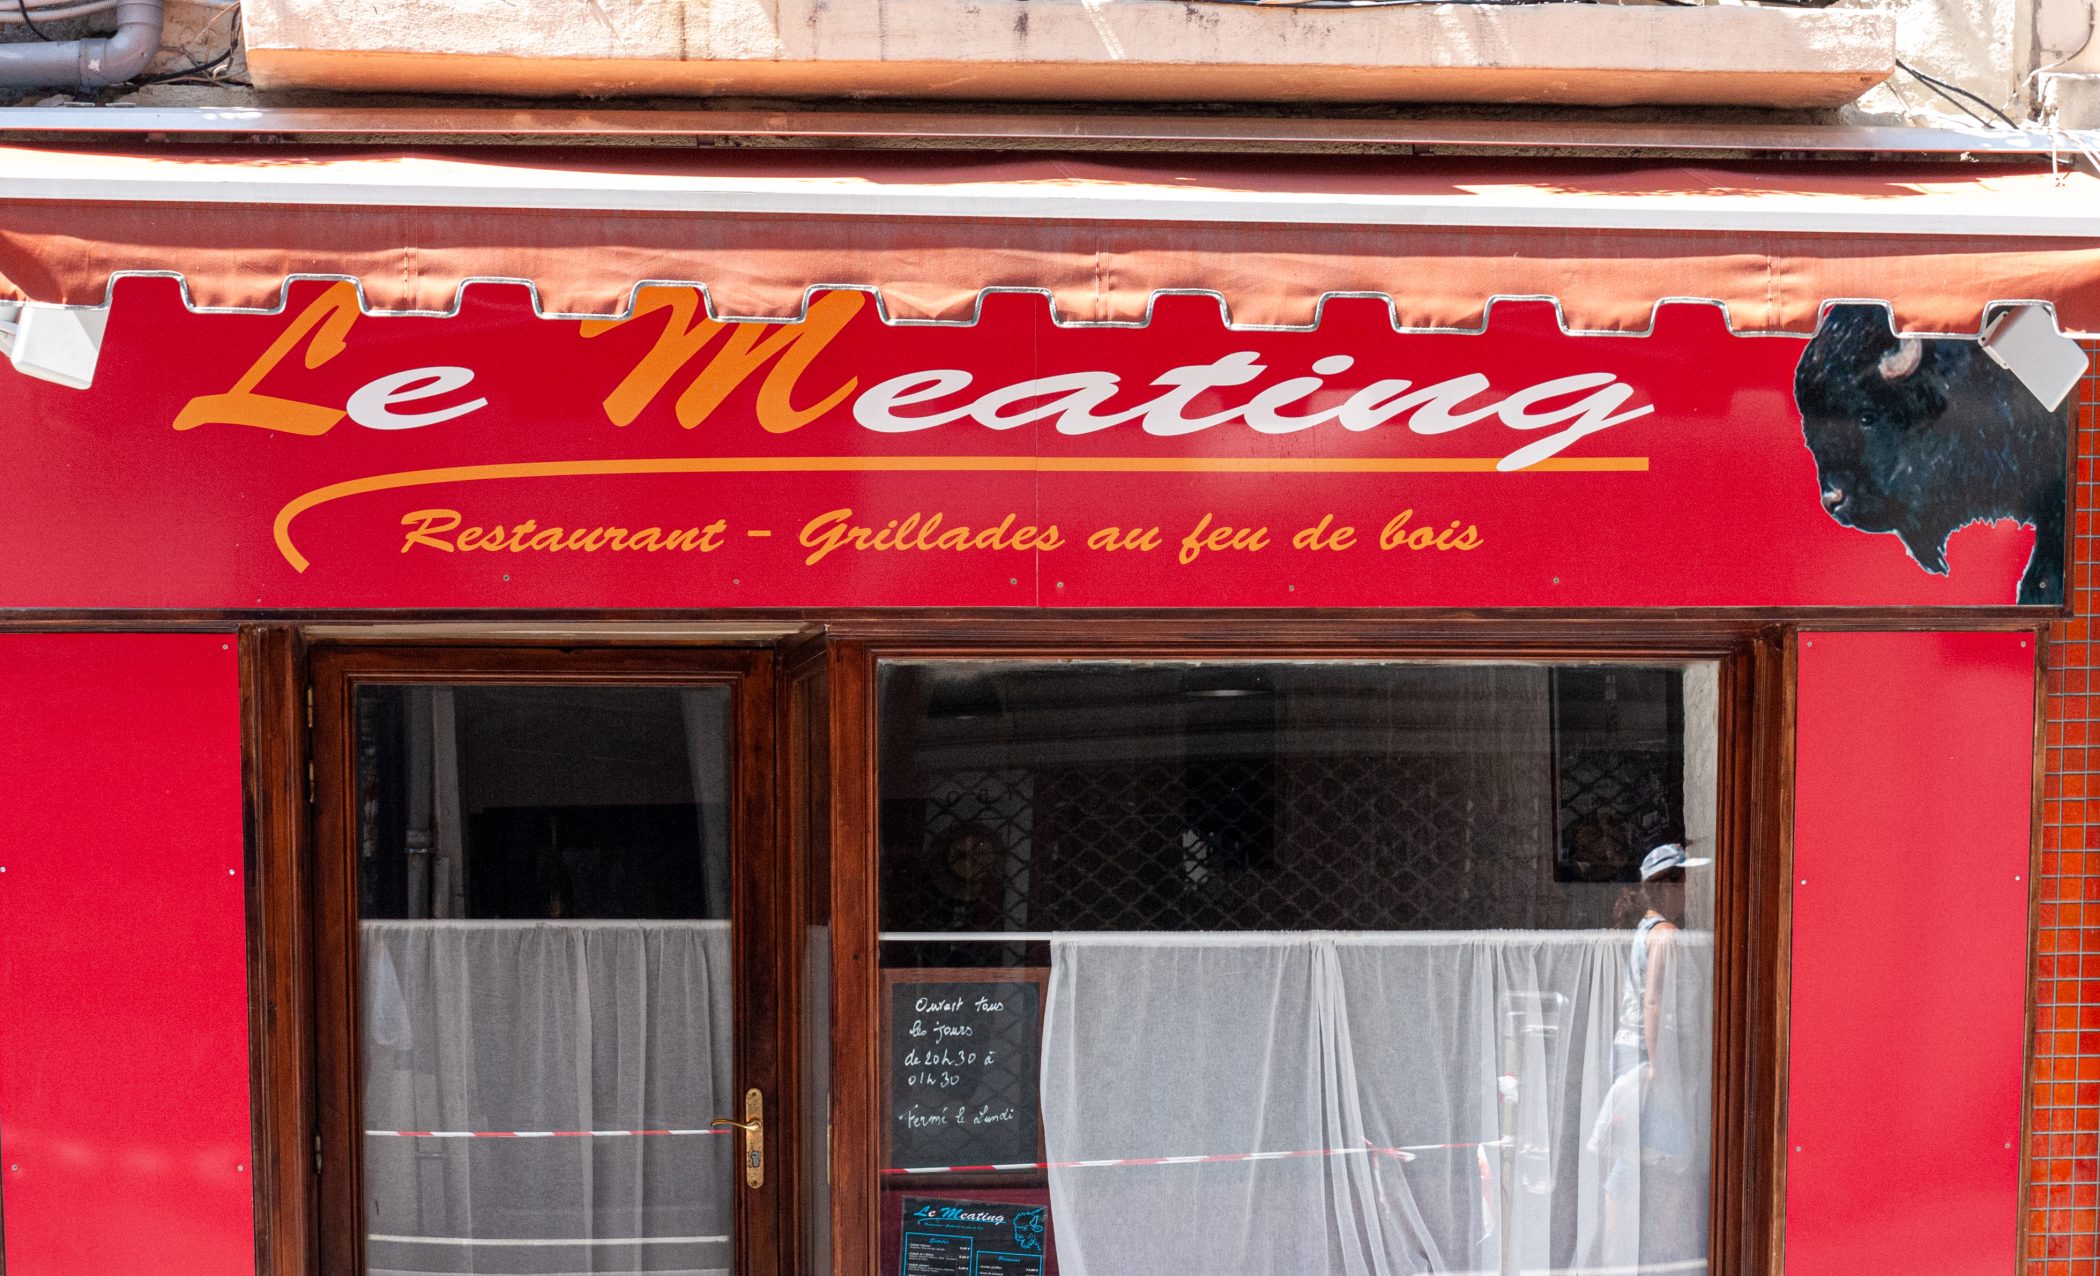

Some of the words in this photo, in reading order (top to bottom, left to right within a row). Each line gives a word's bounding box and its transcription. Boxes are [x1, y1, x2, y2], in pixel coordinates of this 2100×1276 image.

[174, 280, 488, 436] Le
[580, 285, 1655, 472] Meating
[402, 508, 726, 553] Restaurant
[799, 508, 1065, 565] Grillades
[1087, 527, 1161, 551] au
[1179, 513, 1268, 565] feu
[1293, 514, 1357, 551] de
[1380, 509, 1484, 551] bois
[933, 1021, 973, 1044] jours
[904, 1049, 921, 1066] de
[913, 1205, 936, 1217] Le
[940, 1207, 1005, 1225] Meating
